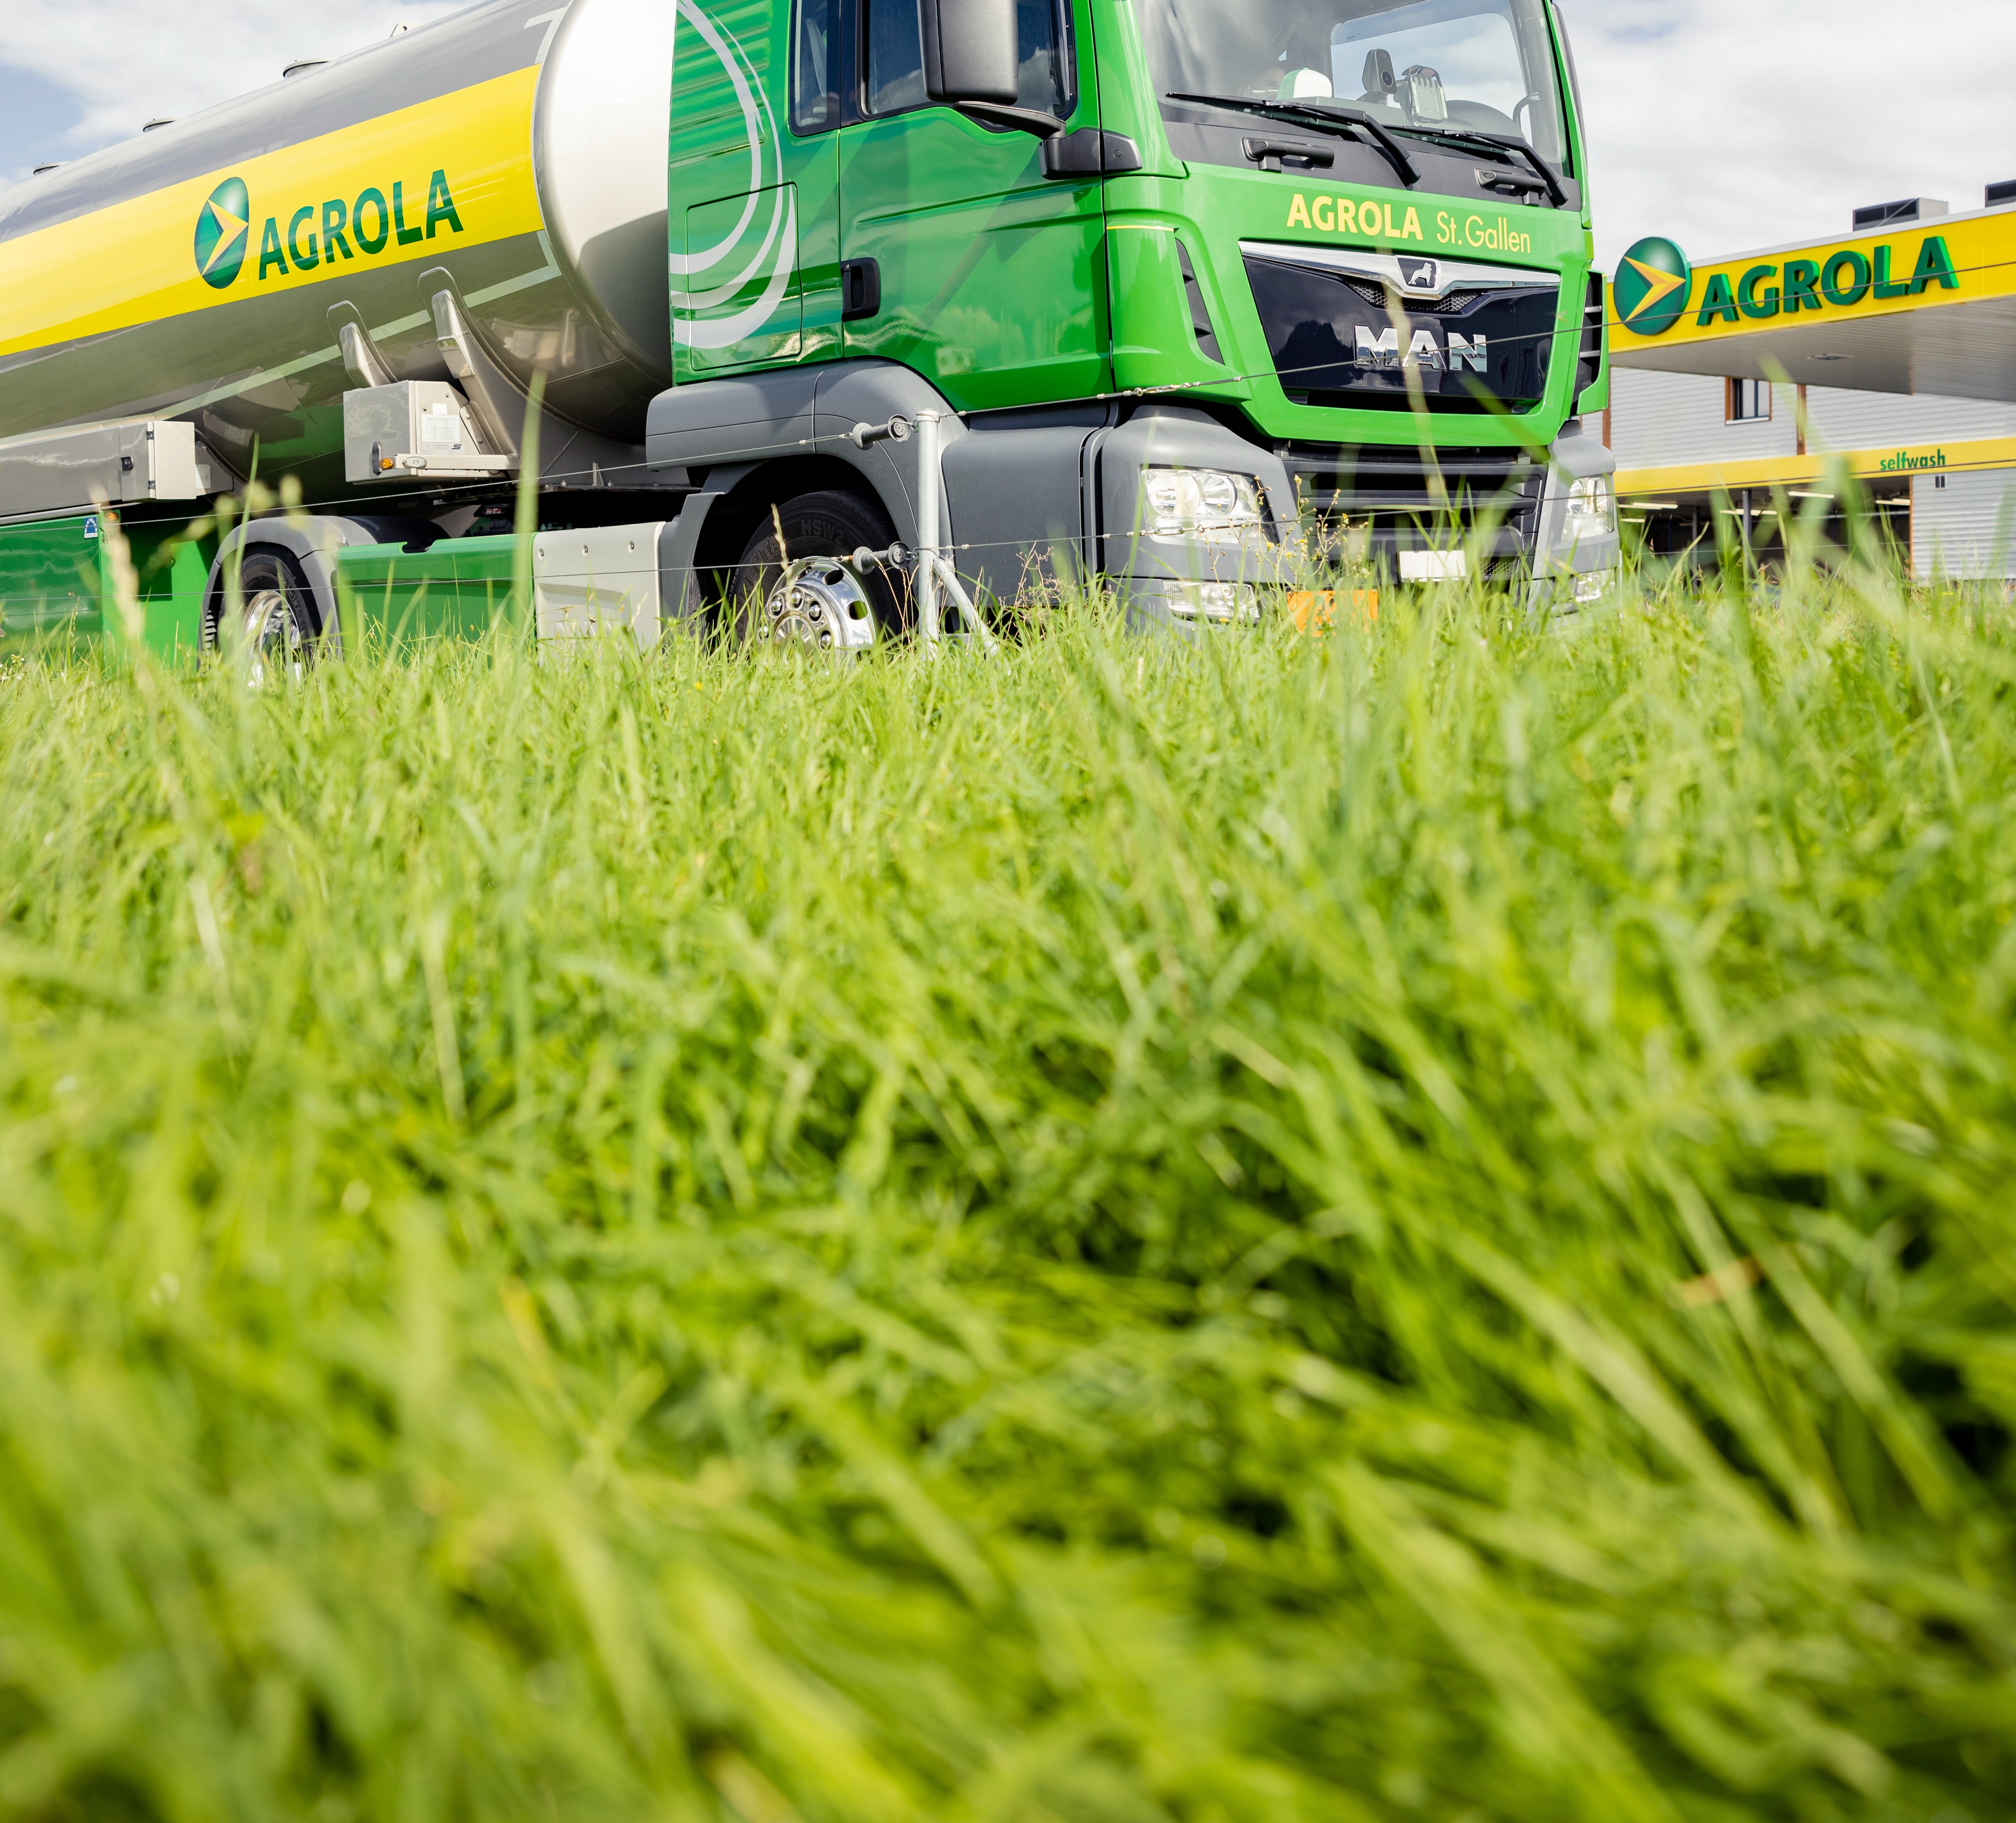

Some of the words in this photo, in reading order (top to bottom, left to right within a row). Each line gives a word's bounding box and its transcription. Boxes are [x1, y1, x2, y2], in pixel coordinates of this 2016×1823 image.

[259, 169, 464, 280] AGROLA
[1286, 194, 1423, 240] AGROLA
[1696, 236, 1959, 326] AGROLA
[1355, 325, 1487, 373] MAN
[1880, 448, 1945, 471] selfwash
[800, 518, 844, 546] HSW2
